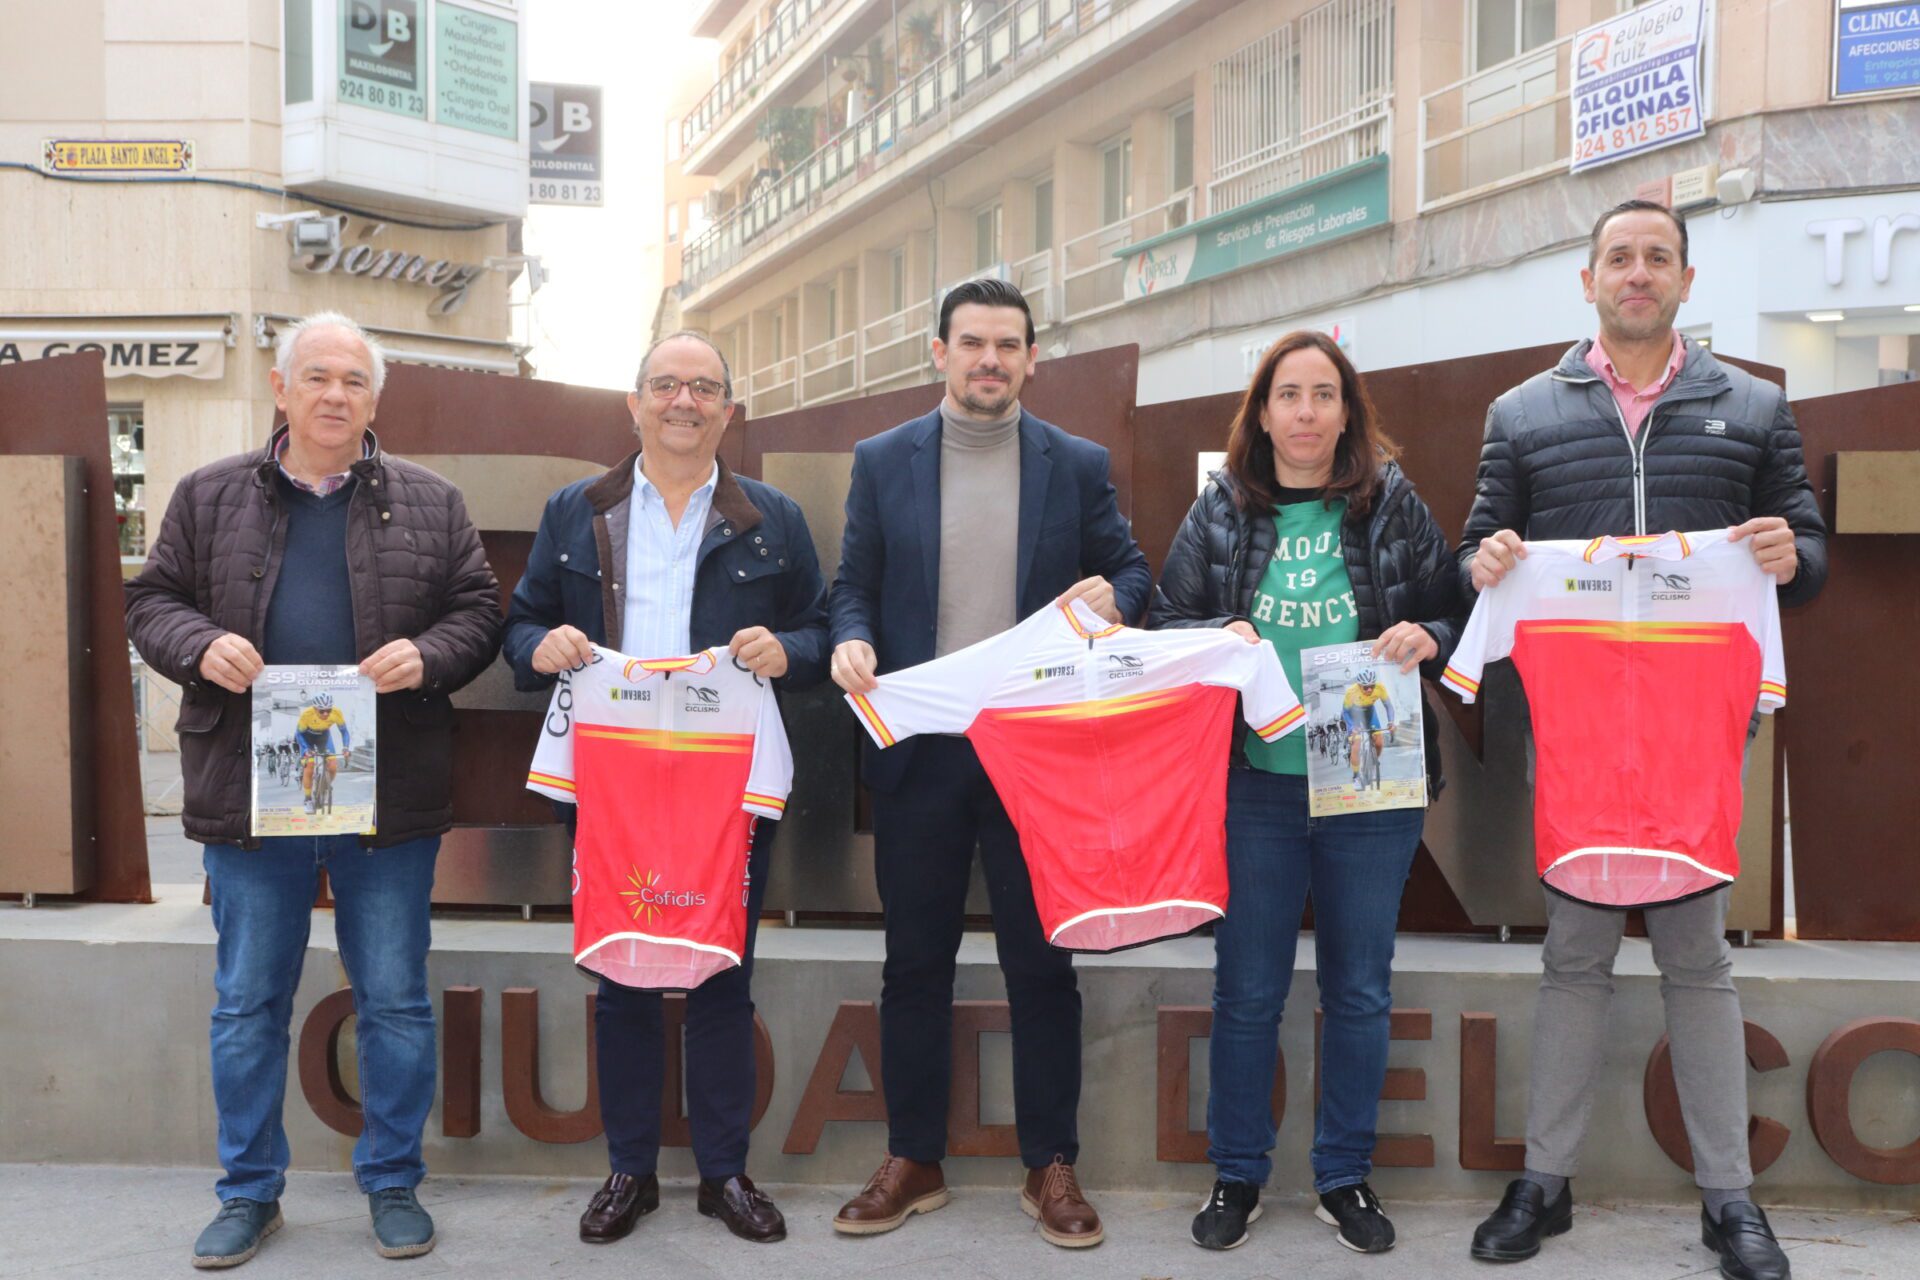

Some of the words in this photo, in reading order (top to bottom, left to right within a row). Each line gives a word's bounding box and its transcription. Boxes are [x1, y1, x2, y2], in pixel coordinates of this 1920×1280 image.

[1615, 5, 1684, 45] eulogio
[445, 27, 506, 52] Maxilofacial
[1848, 38, 1920, 57] AFECCIONES
[453, 45, 504, 68] Implantes
[1613, 42, 1647, 67] ruiz
[349, 57, 413, 82] MAXILODENTAL
[450, 59, 508, 84] Ortodoncia
[339, 79, 364, 99] 924
[368, 86, 384, 104] 80
[388, 90, 403, 108] 81
[408, 95, 424, 114] 23
[1578, 64, 1685, 118] ALQUILA
[449, 107, 509, 131] Periodoncia
[488, 99, 511, 115] Oral
[1576, 85, 1691, 140] OFICINAS
[1612, 121, 1649, 149] 812
[1655, 108, 1692, 136] 557
[80, 147, 107, 165] PLAZA
[111, 147, 139, 165] SANTO
[539, 184, 556, 199] 80
[561, 185, 577, 200] 81
[584, 186, 601, 201] 23
[1216, 225, 1249, 247] Servicio
[1253, 221, 1262, 236] de
[1265, 203, 1315, 231] Prevención
[1265, 236, 1276, 250] de
[1279, 224, 1315, 244] Riesgos
[1318, 206, 1367, 232] Laborales
[1286, 568, 1316, 590] IS
[1314, 652, 1340, 665] 59
[267, 671, 296, 685] 59
[1109, 670, 1143, 680] CICLISMO
[640, 888, 706, 907] Cofidis
